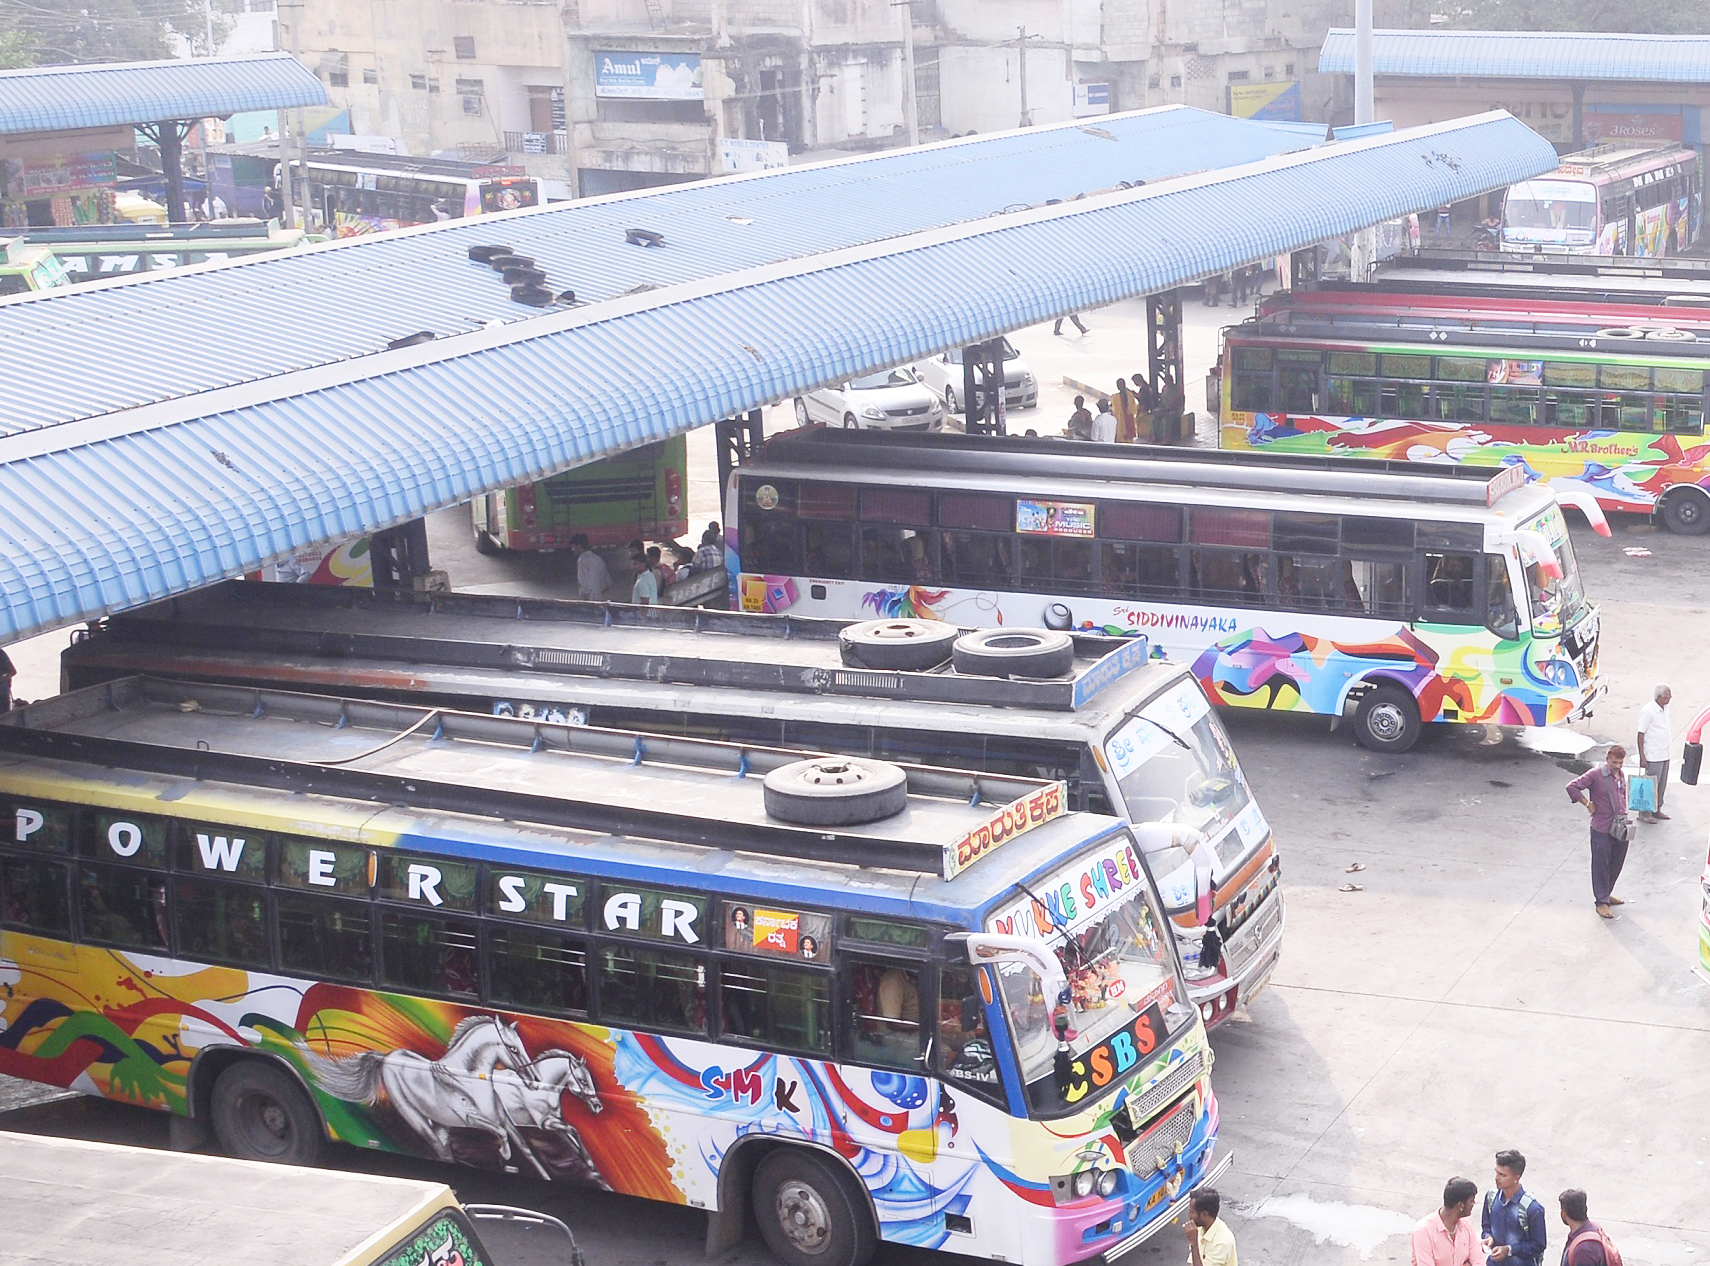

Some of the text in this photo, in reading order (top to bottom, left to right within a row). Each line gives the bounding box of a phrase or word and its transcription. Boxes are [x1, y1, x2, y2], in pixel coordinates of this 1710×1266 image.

[602, 58, 641, 75] Amul
[1055, 520, 1091, 530] MUSIC
[1127, 612, 1237, 633] SIDDIVINAYAKA
[957, 803, 1027, 867] ಮಾರುತಿ
[1080, 846, 1139, 909] SHREE
